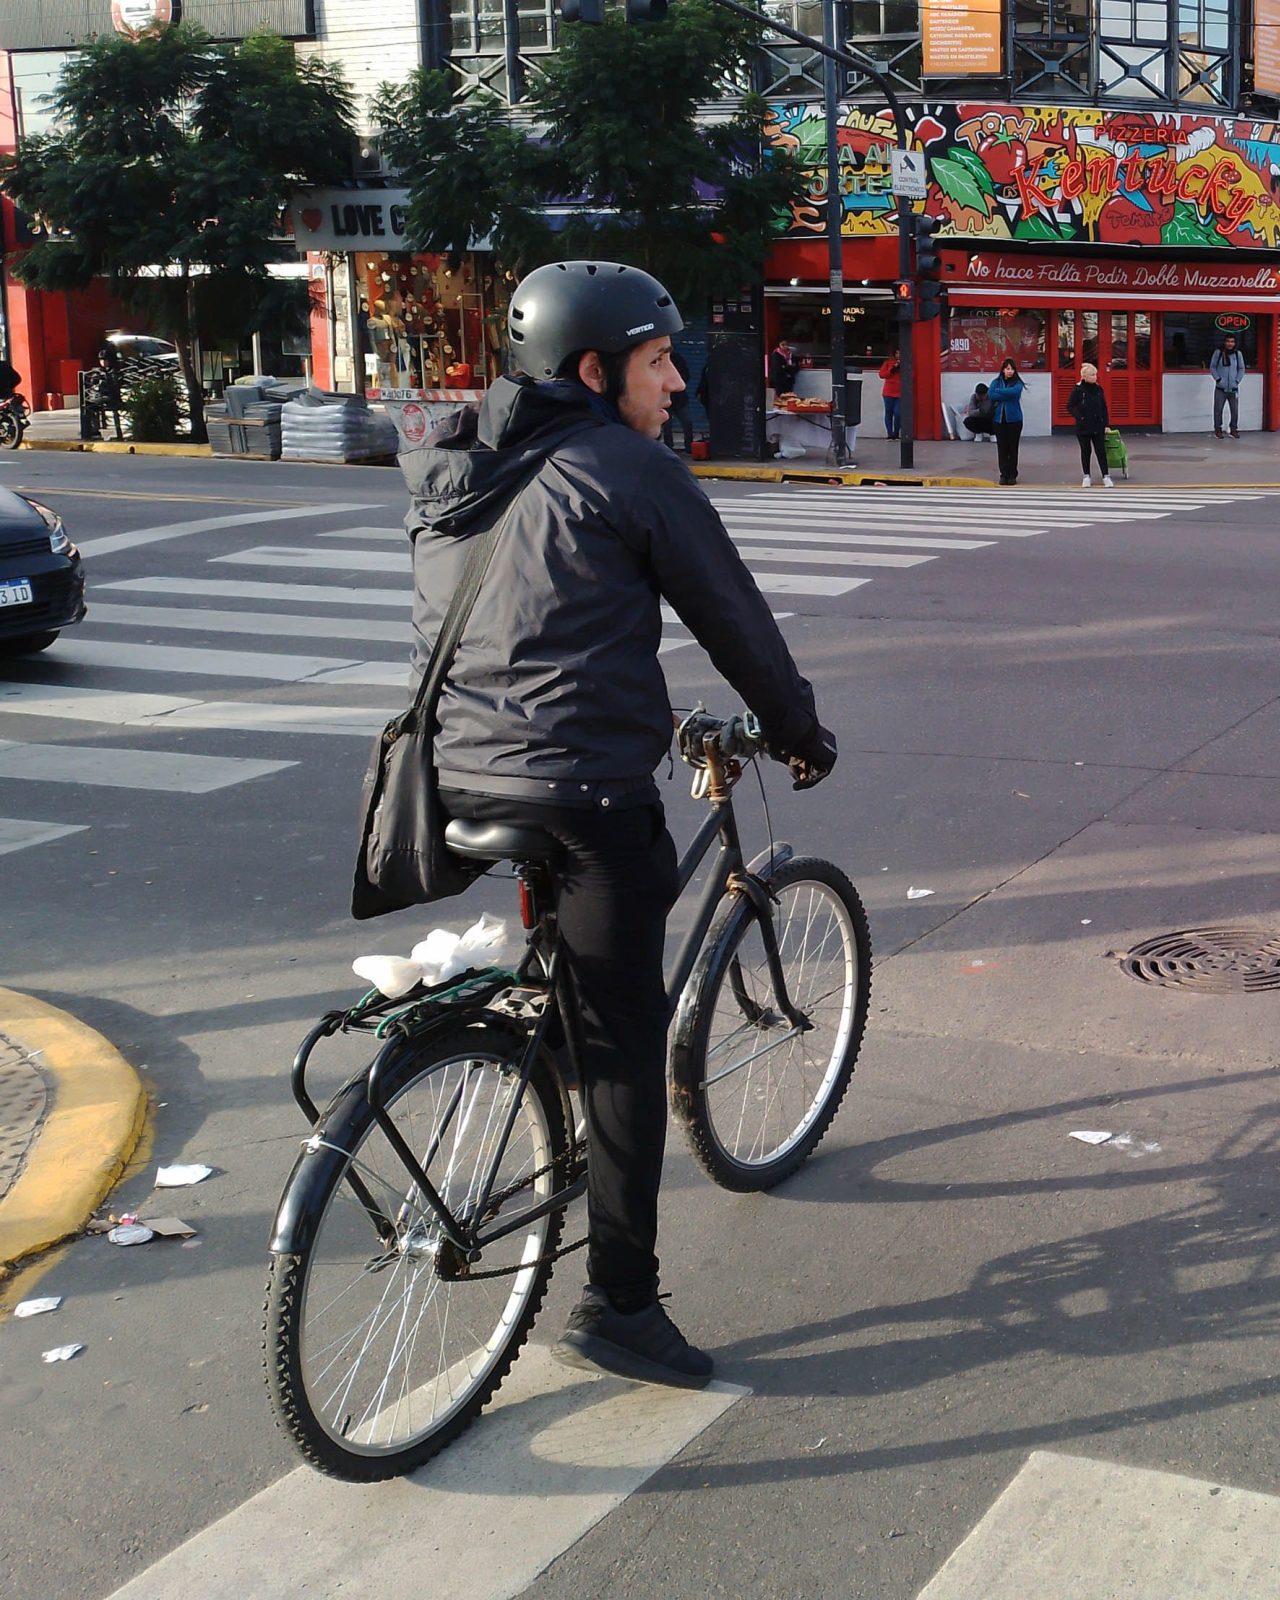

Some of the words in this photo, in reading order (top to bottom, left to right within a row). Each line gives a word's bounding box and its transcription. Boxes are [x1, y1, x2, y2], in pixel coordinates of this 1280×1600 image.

[1094, 125, 1189, 145] PIZZERIA
[1010, 149, 1257, 235] Kentucky
[331, 204, 386, 236] LOVE
[966, 259, 991, 278] No
[994, 258, 1035, 280] hace
[1036, 262, 1082, 283] Falta
[1084, 264, 1128, 285] Pedir
[1132, 264, 1180, 287] Doble
[1183, 267, 1278, 289] Muzzarella
[1217, 315, 1248, 328] OPEN
